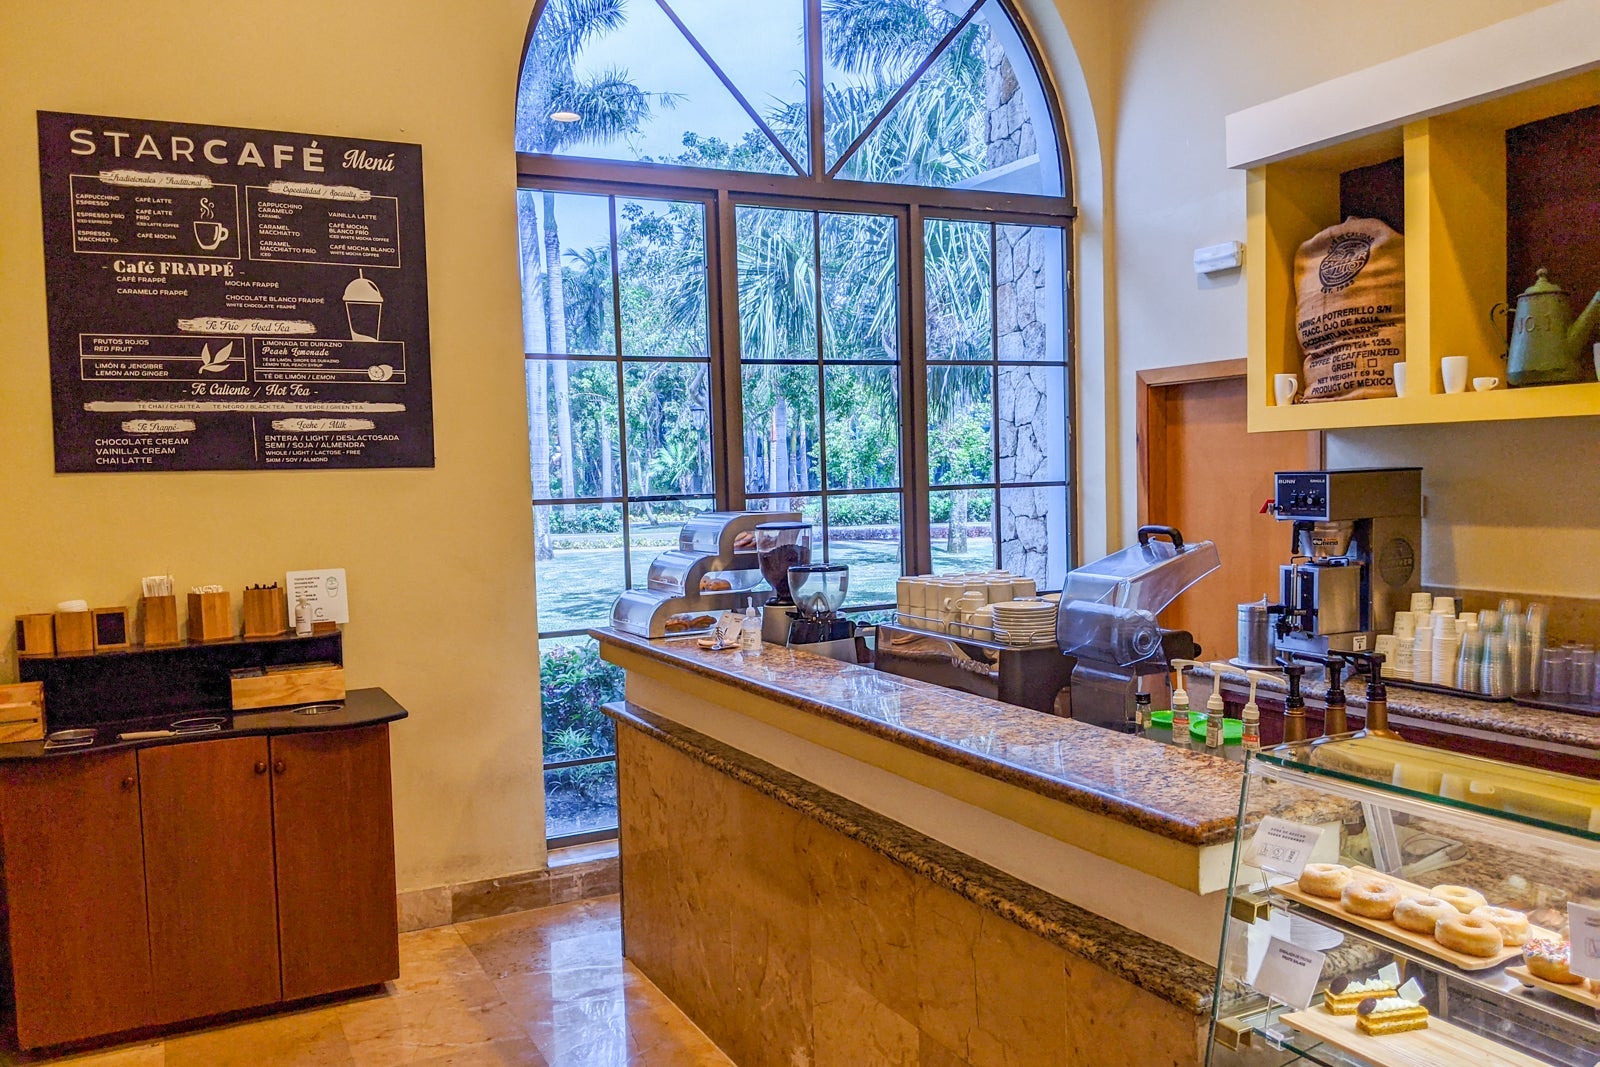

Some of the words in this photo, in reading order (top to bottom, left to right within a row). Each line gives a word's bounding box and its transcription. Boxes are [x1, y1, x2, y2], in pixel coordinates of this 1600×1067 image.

[69, 129, 325, 172] STARCAFÉ
[342, 149, 395, 172] Menú
[165, 177, 203, 187] Traditional
[282, 185, 321, 197] Especialidad
[329, 189, 357, 199] Specialty
[135, 196, 151, 204] CAFÉ
[257, 207, 294, 215] CARAMELO
[328, 222, 346, 230] CAFÉ
[259, 229, 300, 237] MACCHIATTO
[260, 246, 301, 254] MACCHIATTO
[113, 259, 155, 274] Café
[160, 261, 234, 277] FRAPPÉ
[116, 275, 137, 283] CAFÉ
[138, 276, 167, 284] FRAPPÉ
[225, 280, 251, 288] MOCHA
[252, 281, 279, 289] FRAPPÉ
[116, 288, 158, 296] CARAMELO
[159, 289, 188, 297] FRAPPÉ
[225, 294, 268, 302] CHOCOLATE
[298, 296, 325, 305] FRAPPÉ
[1315, 316, 1322, 324] A
[1322, 305, 1375, 322] POTRERILLO
[251, 320, 271, 332] Iced
[274, 322, 290, 332] Tea
[1323, 321, 1339, 332] OJO
[1340, 318, 1353, 327] DE
[262, 347, 288, 356] Peach
[291, 347, 329, 357] Lemonade
[1332, 348, 1400, 364] DECAFFEINATED
[1331, 361, 1357, 373] GREEN
[1317, 376, 1328, 385] NET
[1330, 370, 1358, 382] WEIGHT
[1372, 369, 1385, 377] kg
[209, 383, 250, 396] Caliente
[265, 384, 286, 396] Hot
[289, 384, 311, 396] Tea
[1311, 382, 1342, 396] PRODUCT
[1343, 380, 1355, 390] OF
[297, 421, 318, 430] Leche
[328, 421, 347, 429] Milk
[95, 438, 153, 446] CHOCOLATE
[142, 447, 176, 455] CREAM
[96, 457, 119, 465] CHAI
